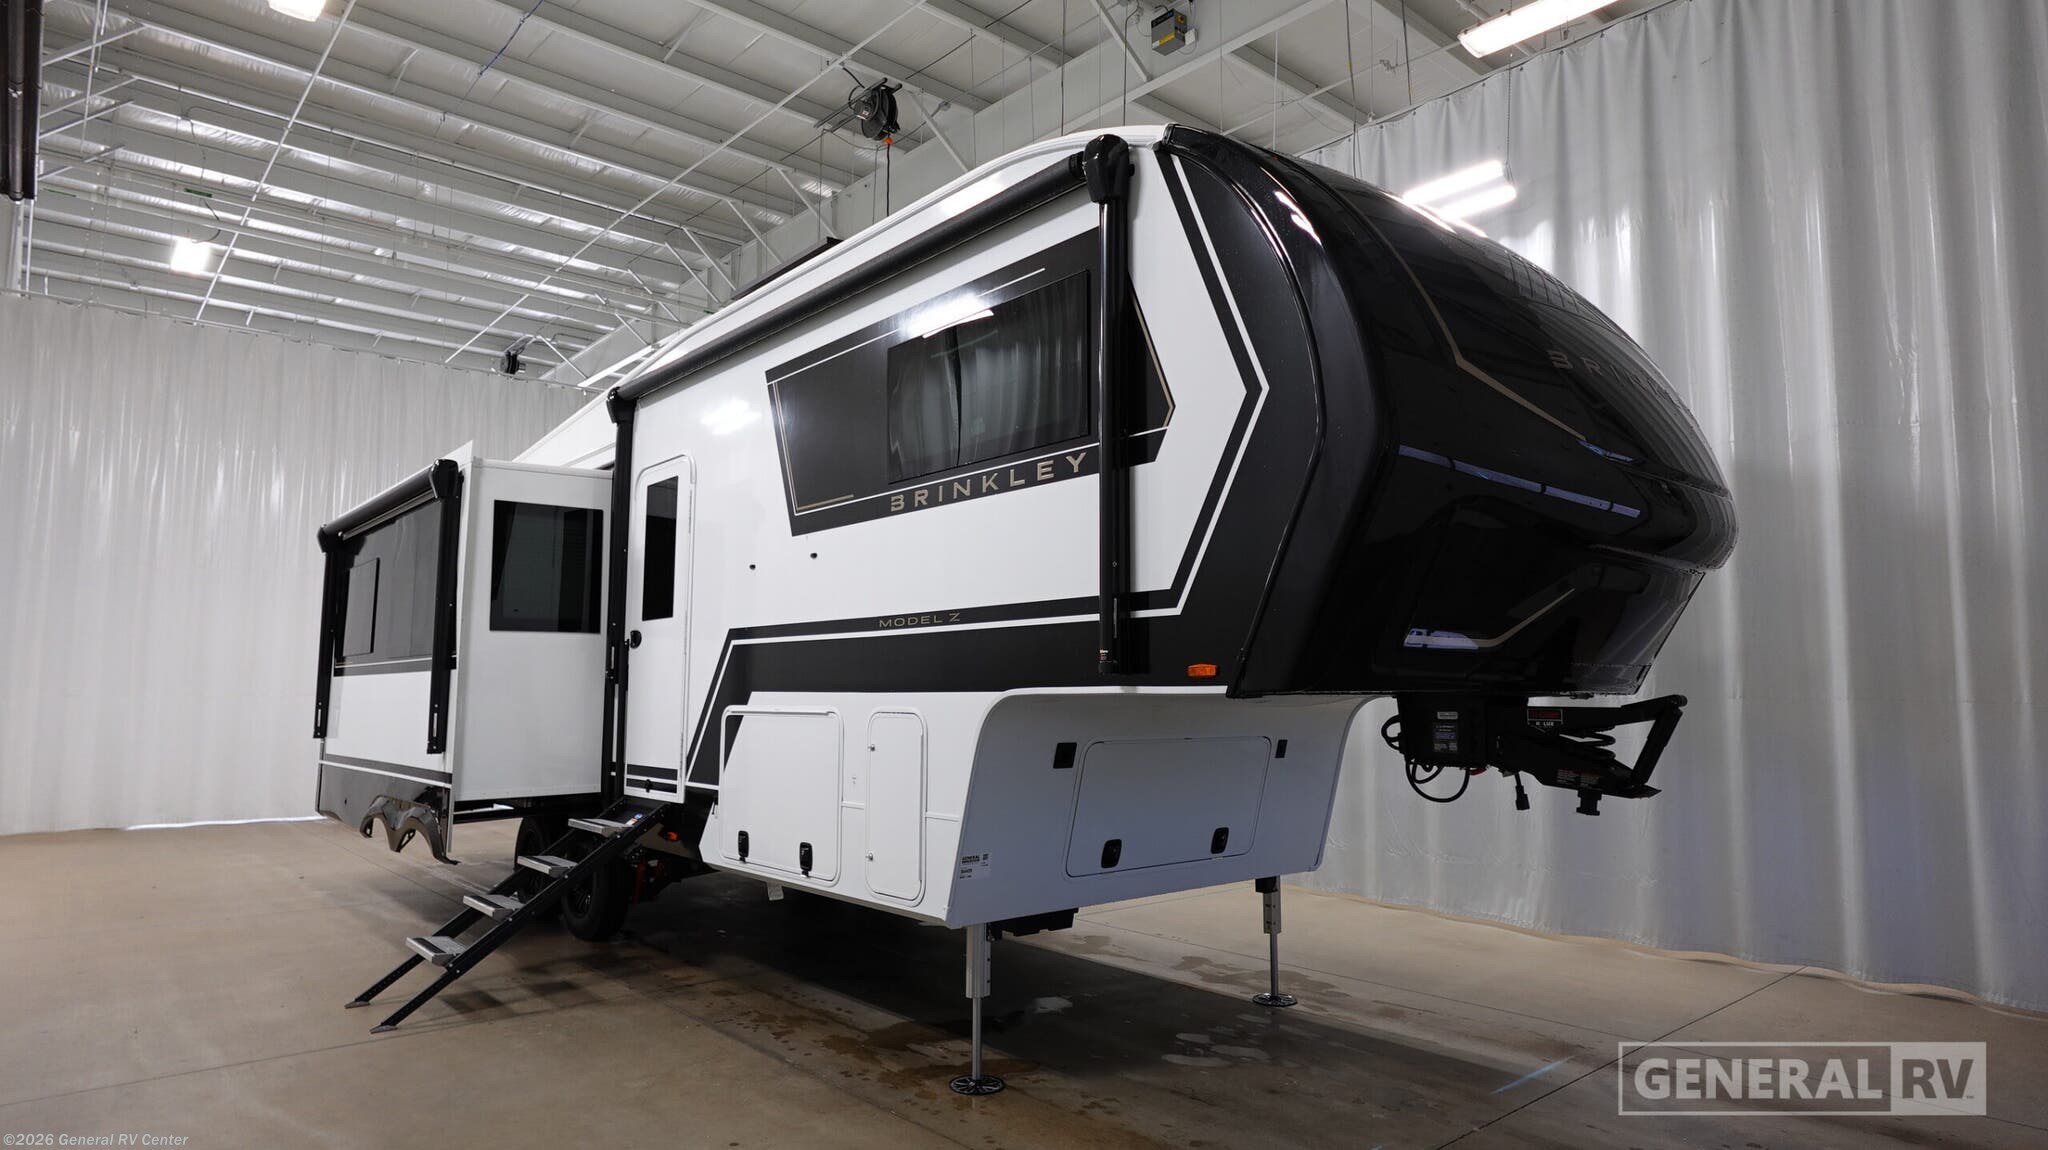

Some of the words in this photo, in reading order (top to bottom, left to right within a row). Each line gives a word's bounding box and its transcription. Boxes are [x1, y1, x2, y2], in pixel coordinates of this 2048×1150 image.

[890, 452, 1087, 512] BRINKLEY
[879, 614, 943, 628] MODEL
[949, 612, 961, 622] Z
